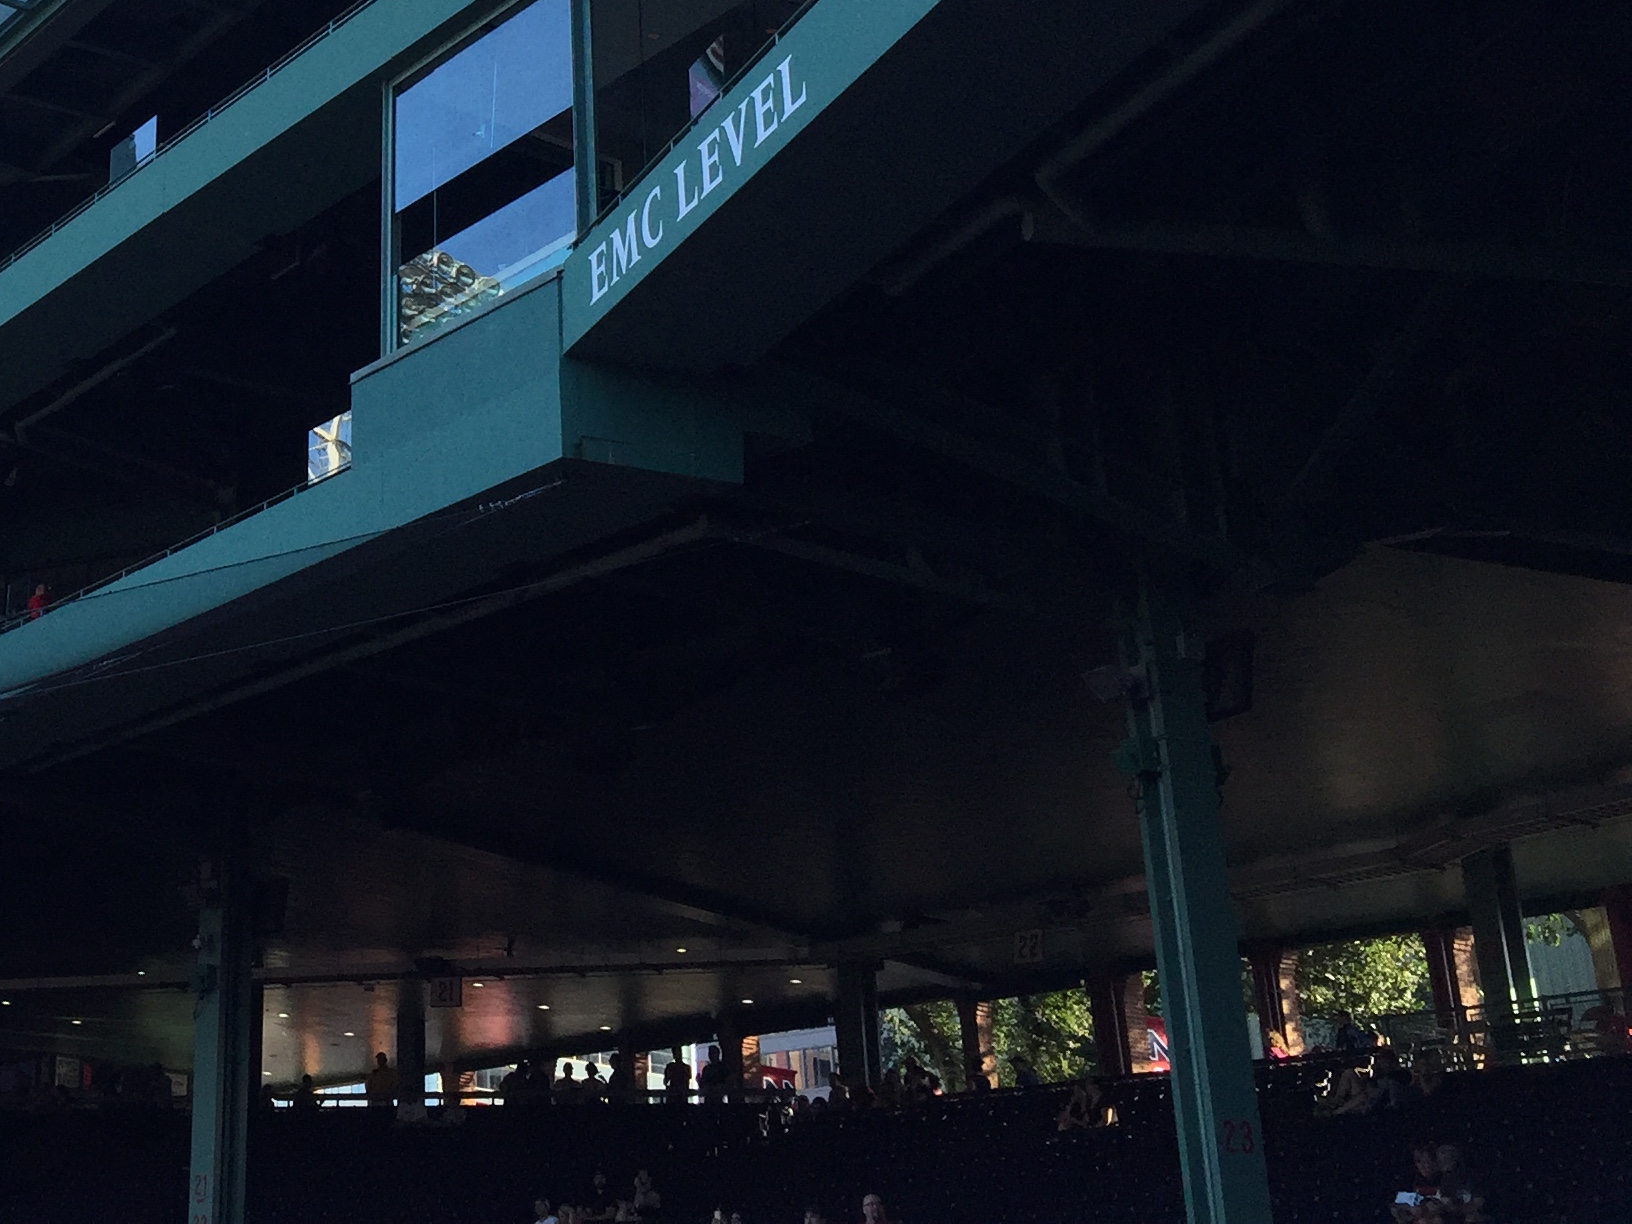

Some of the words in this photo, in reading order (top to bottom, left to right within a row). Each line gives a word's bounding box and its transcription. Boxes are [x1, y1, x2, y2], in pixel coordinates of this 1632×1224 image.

[588, 185, 663, 307] EMC
[673, 53, 807, 222] LEVEL
[1018, 934, 1038, 958] 22
[438, 980, 454, 1002] 21
[1223, 1119, 1255, 1154] 23
[194, 1174, 207, 1197] 21
